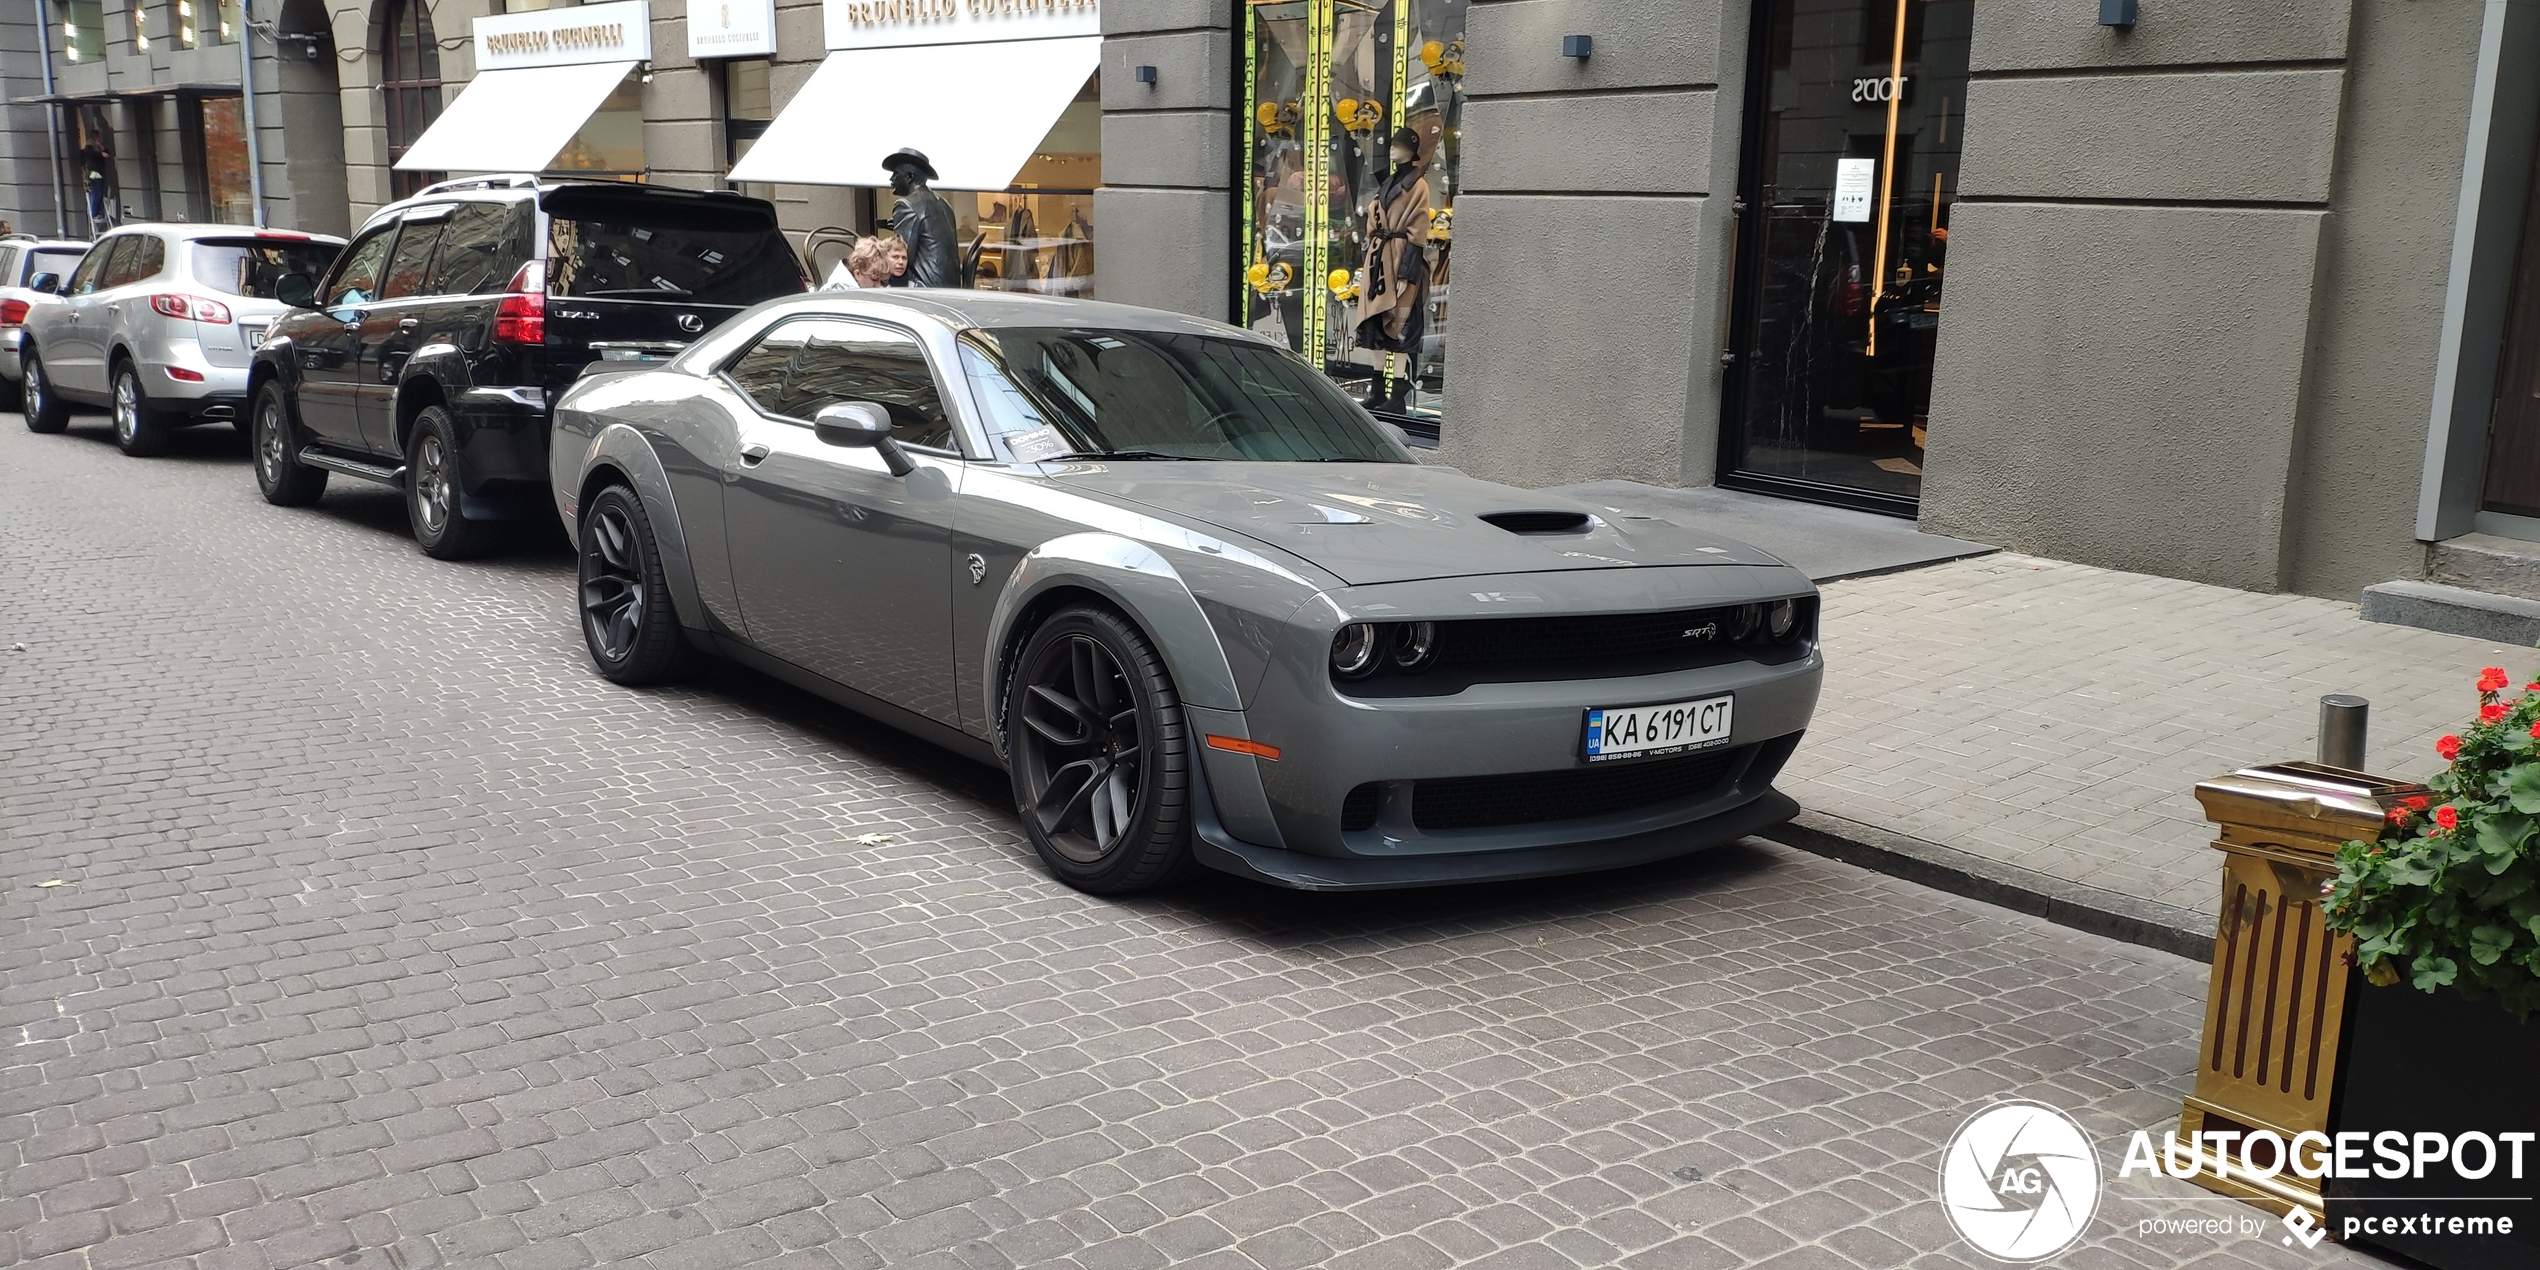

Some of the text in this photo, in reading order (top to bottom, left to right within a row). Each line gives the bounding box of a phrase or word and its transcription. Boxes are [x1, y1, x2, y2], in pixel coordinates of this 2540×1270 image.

[848, 0, 956, 23] BRUNELLO
[487, 23, 624, 50] BRUNELLO CUCINELLI
[696, 35, 726, 45] BRUNELLO
[1394, 46, 1405, 103] ROCK
[1318, 51, 1330, 206] ROCK CLIMBING
[1316, 247, 1326, 297] ROCK
[554, 310, 600, 319] LEXUS
[1010, 428, 1051, 446] DOMINO
[1682, 627, 1710, 638] SRT
[1604, 702, 1728, 747] KA 6191 CT
[1588, 738, 1600, 749] UA
[1649, 746, 1683, 756] V-MOTORS
